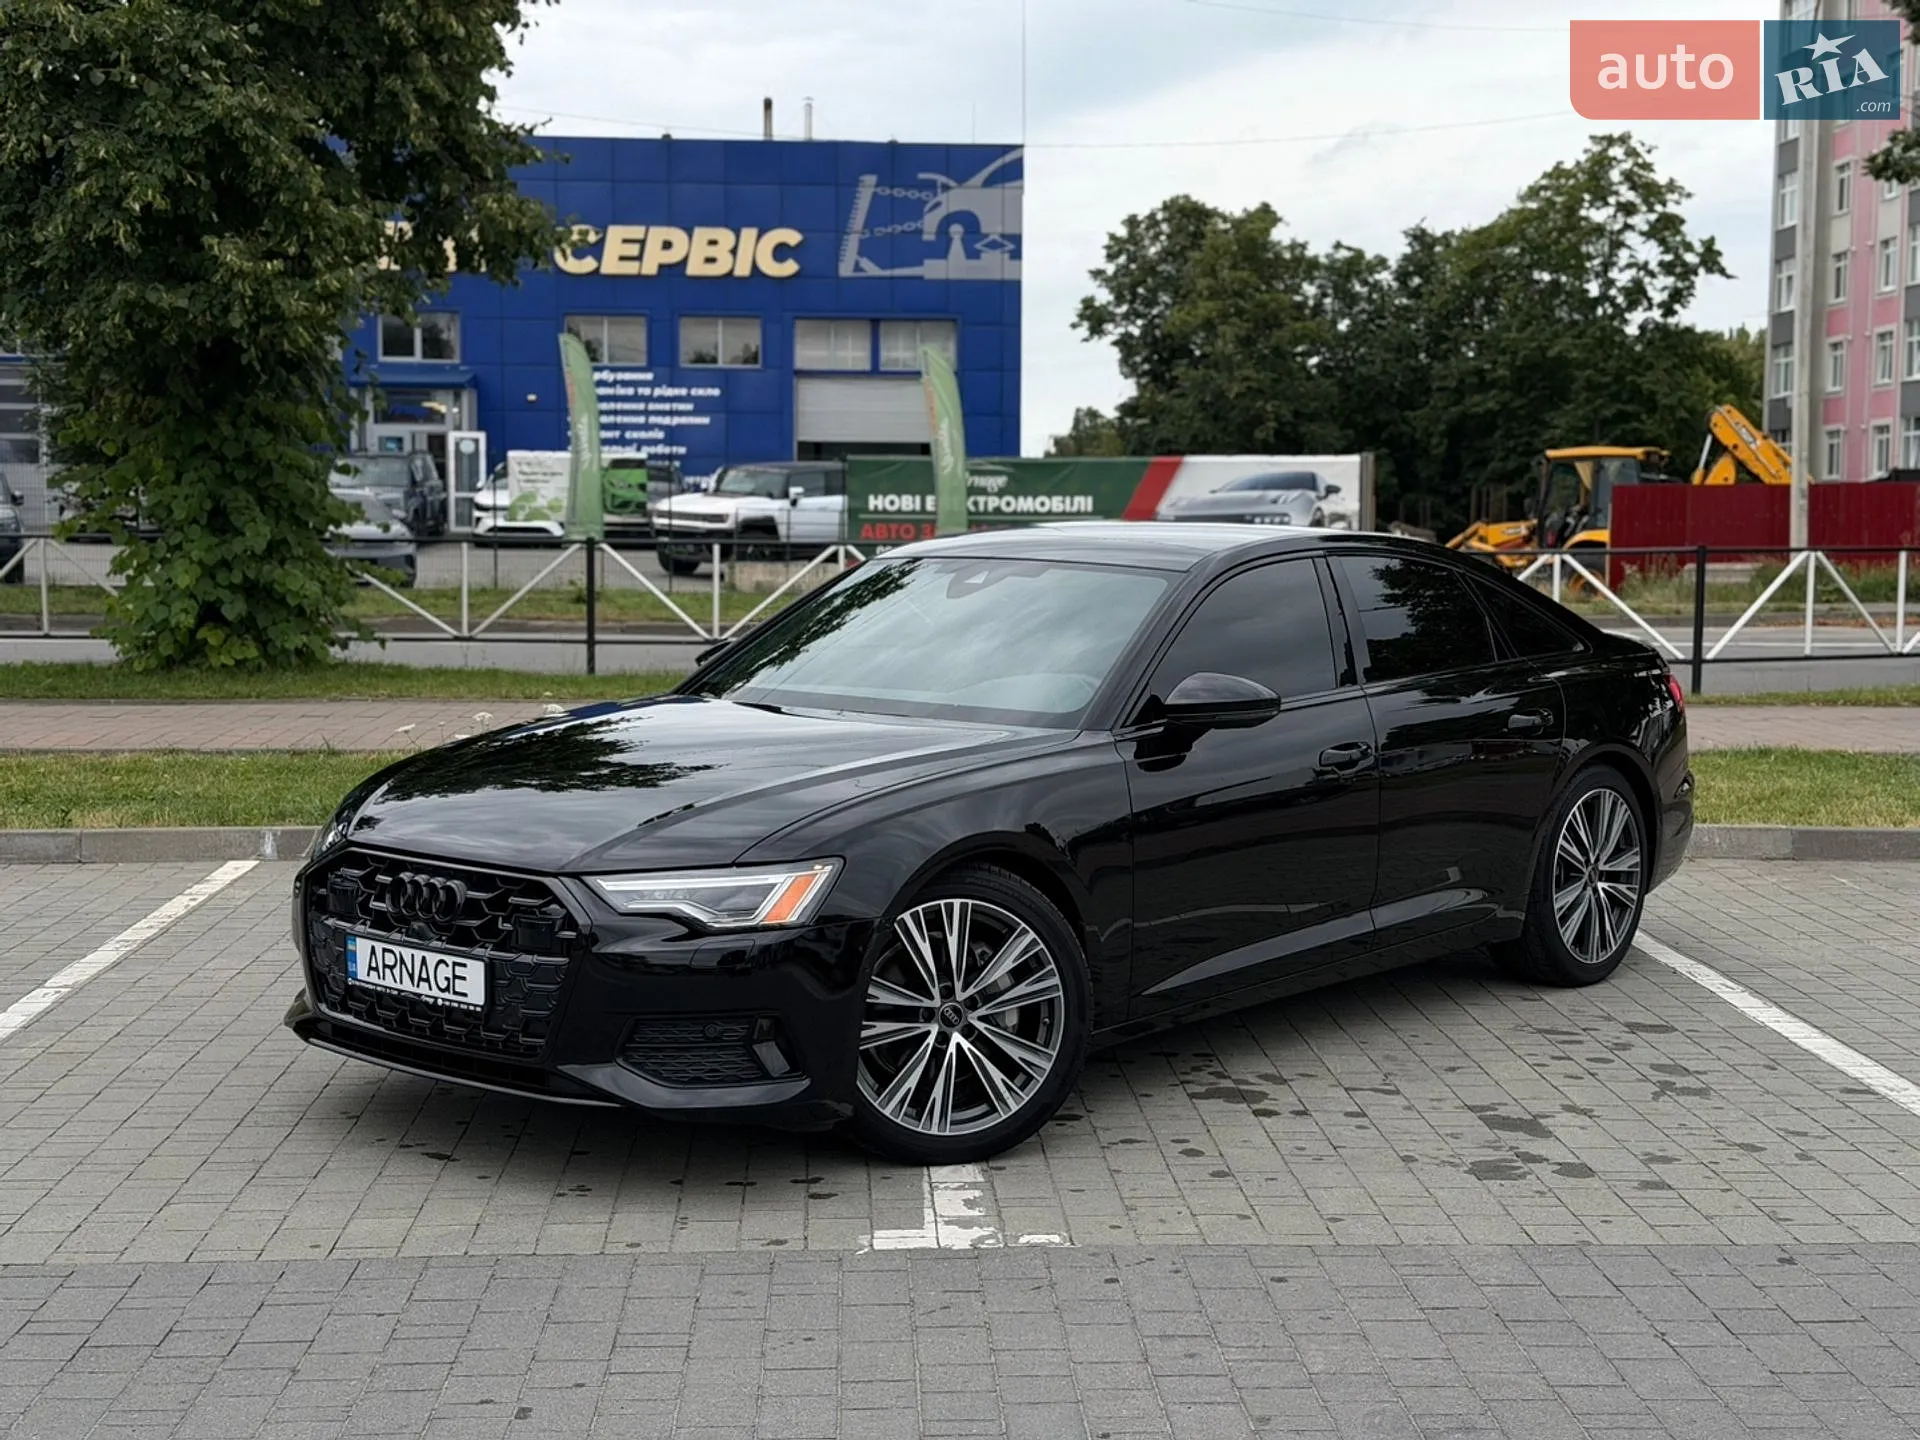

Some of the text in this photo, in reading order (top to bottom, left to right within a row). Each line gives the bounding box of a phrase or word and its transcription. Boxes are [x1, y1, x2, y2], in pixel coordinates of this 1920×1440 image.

[553, 224, 804, 278] СЕРВІС
[868, 494, 1094, 513] НОВІ ЕКТРОМОБІЛІ
[860, 523, 915, 540] АВТО
[367, 945, 468, 998] ARNAGE
